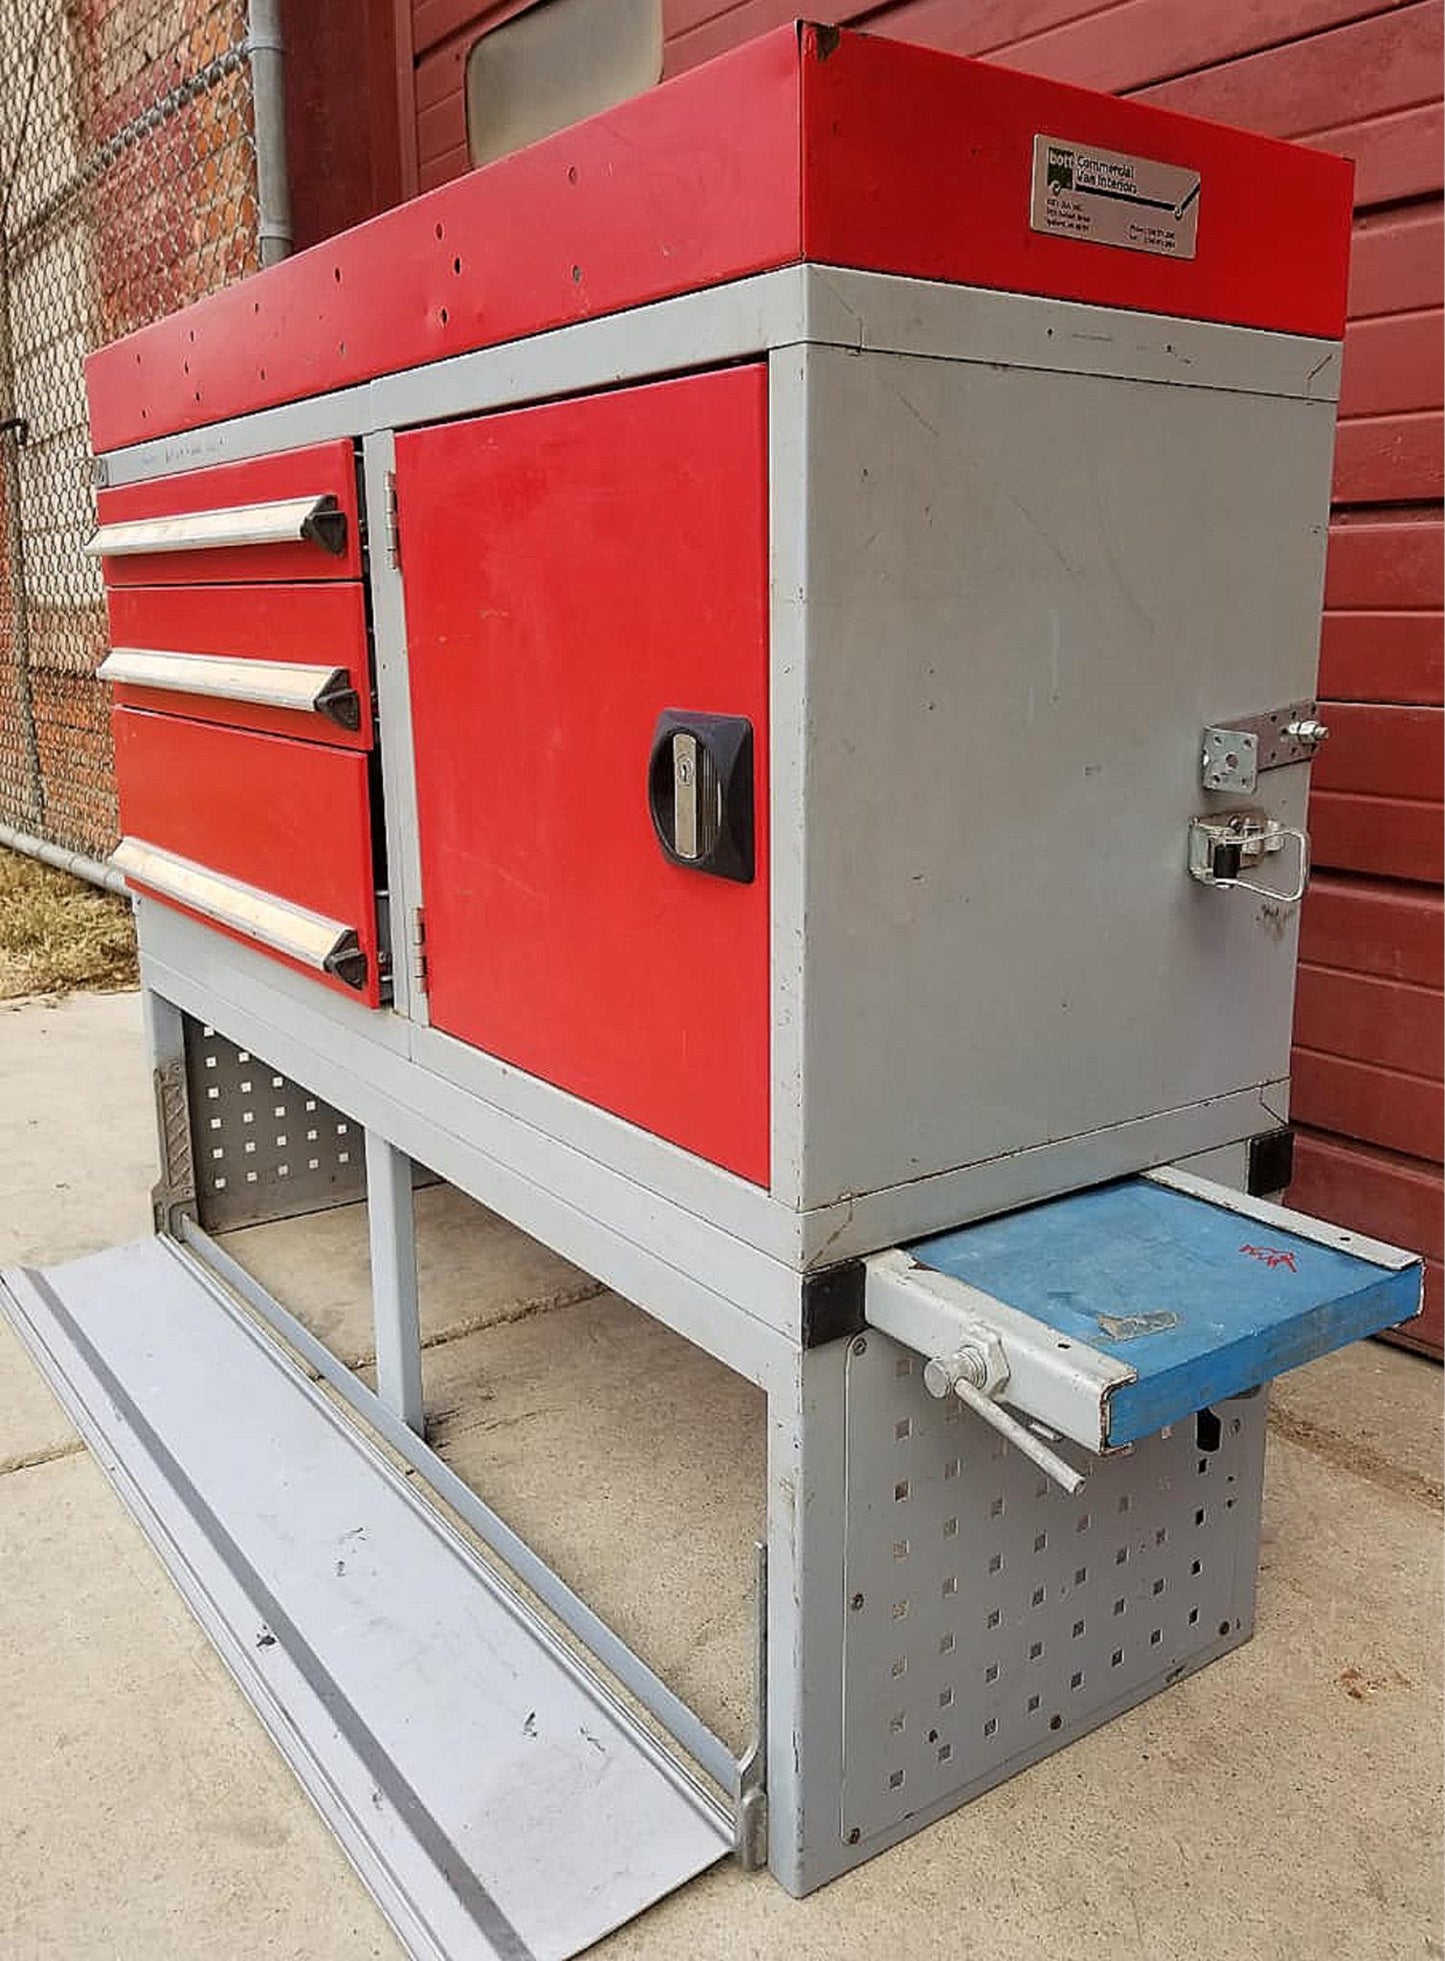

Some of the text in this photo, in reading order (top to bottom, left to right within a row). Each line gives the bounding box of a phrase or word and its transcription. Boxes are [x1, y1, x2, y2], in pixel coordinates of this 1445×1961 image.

[1077, 156, 1134, 179] Commercial
[1077, 169, 1137, 194] Van Interiors
